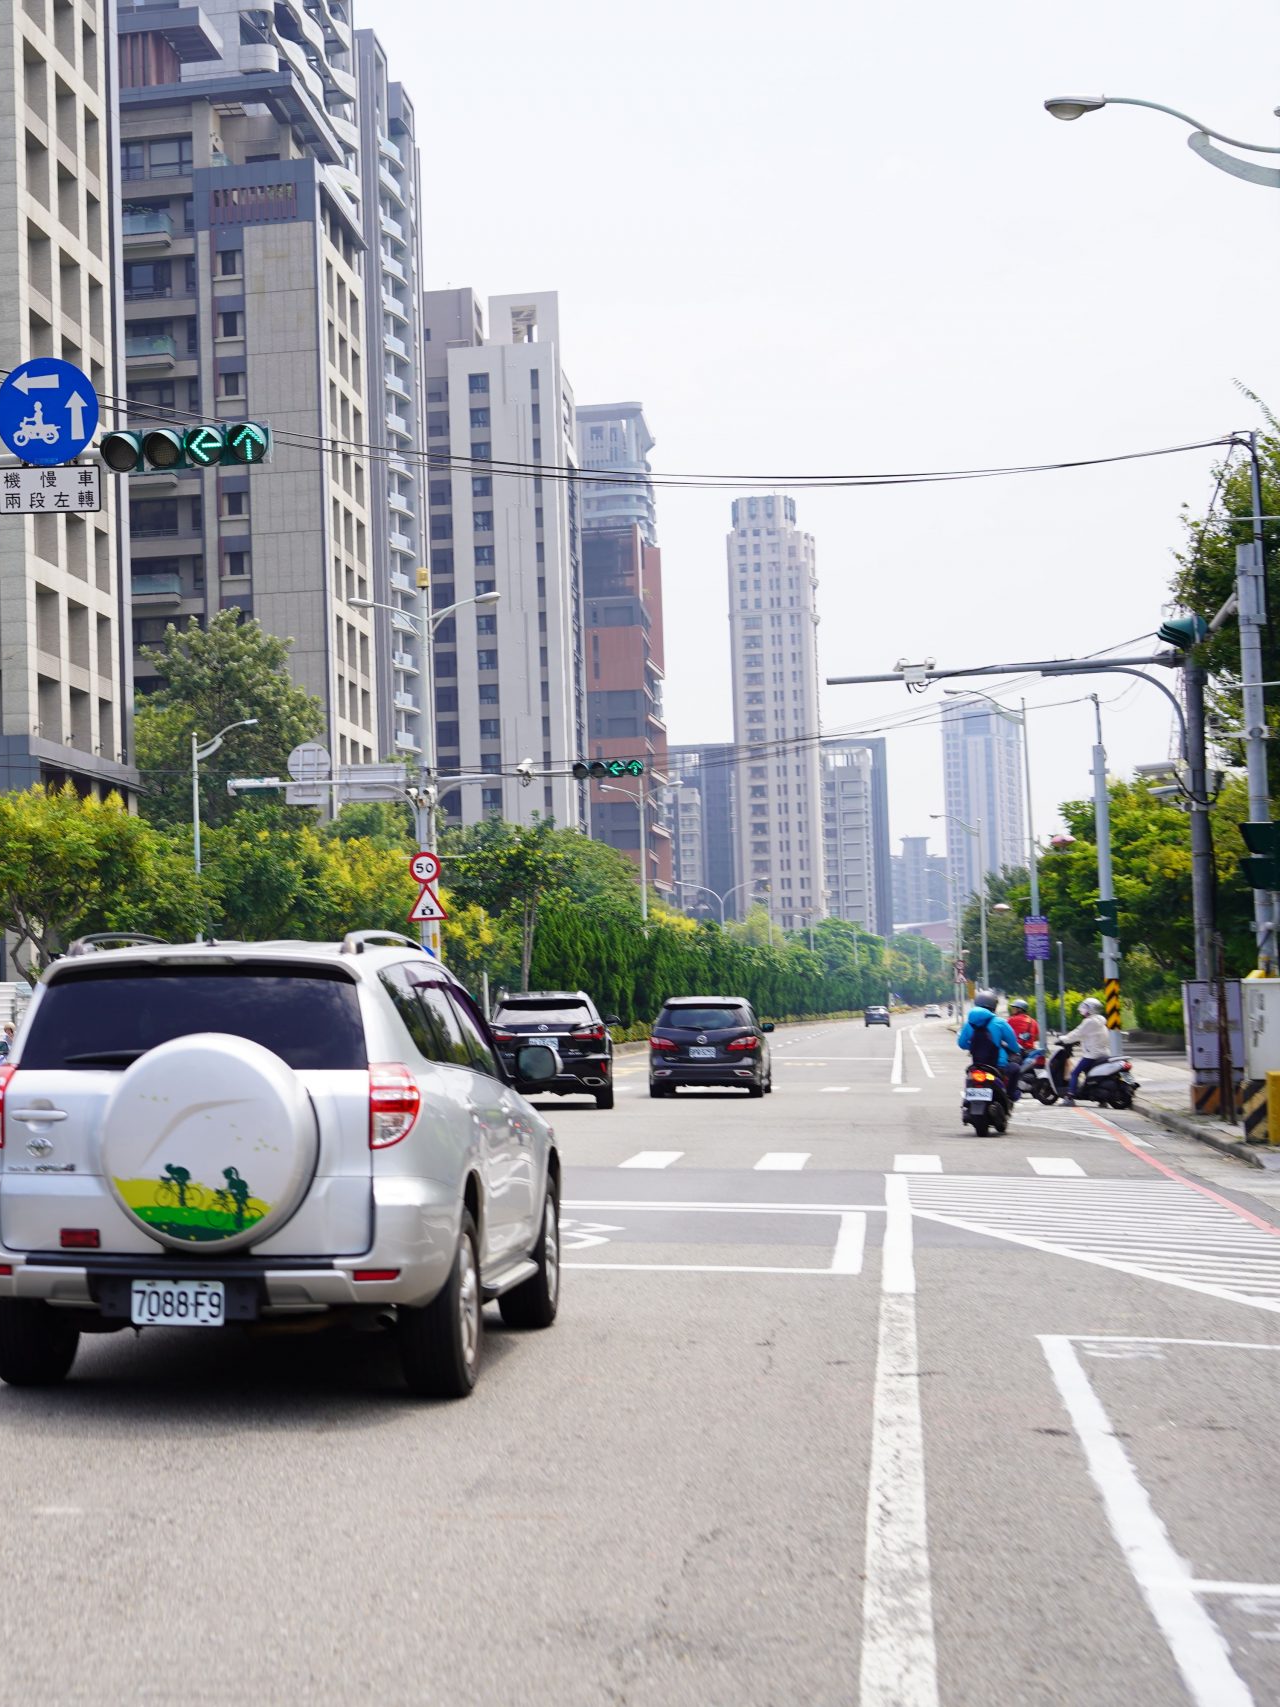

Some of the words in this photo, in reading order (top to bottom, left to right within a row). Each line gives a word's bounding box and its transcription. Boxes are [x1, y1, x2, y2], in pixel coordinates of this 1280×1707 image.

[3, 469, 94, 489] 機慢車
[4, 489, 95, 509] 兩段左轉
[416, 863, 434, 873] 50
[132, 1290, 221, 1318] 7088-F9
